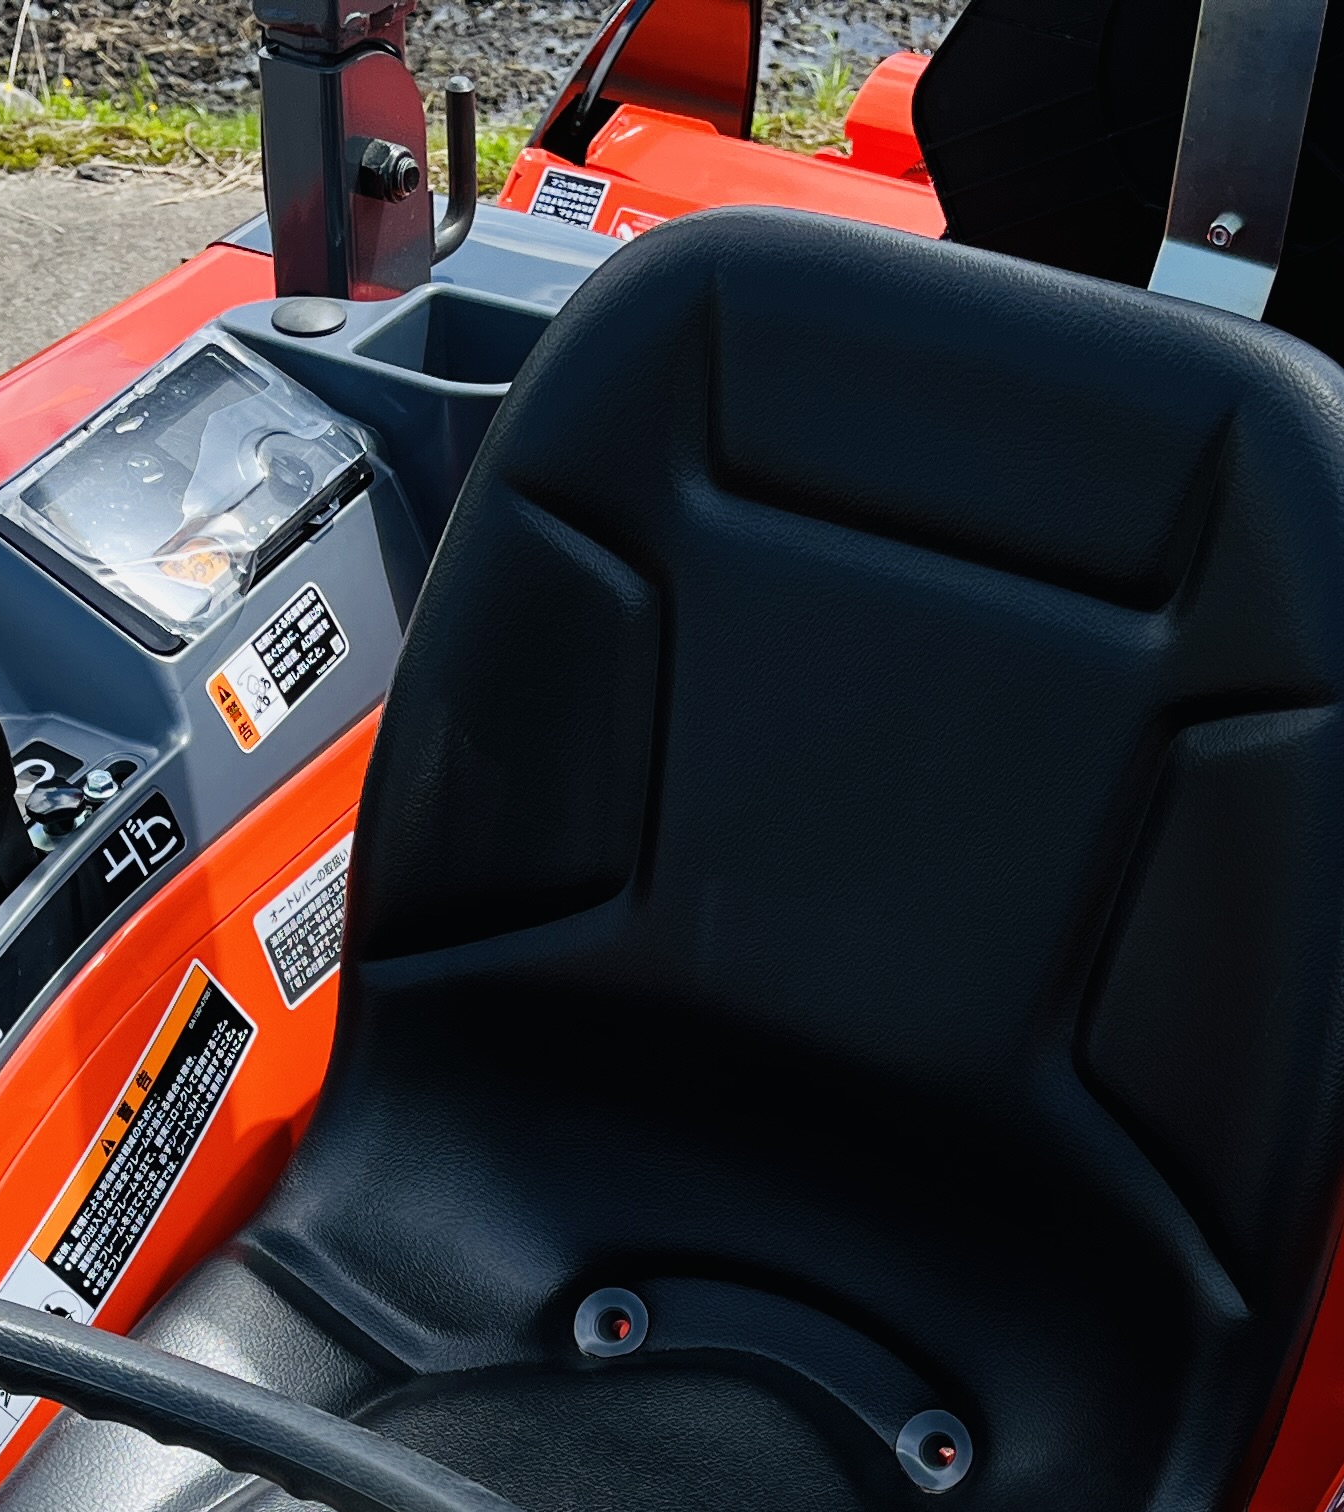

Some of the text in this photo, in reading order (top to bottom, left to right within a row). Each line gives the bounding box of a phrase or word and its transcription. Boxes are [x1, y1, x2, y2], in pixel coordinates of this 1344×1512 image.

[224, 698, 254, 743] 警告
[103, 815, 177, 883] 上げ
[115, 1067, 153, 1125] 警告
